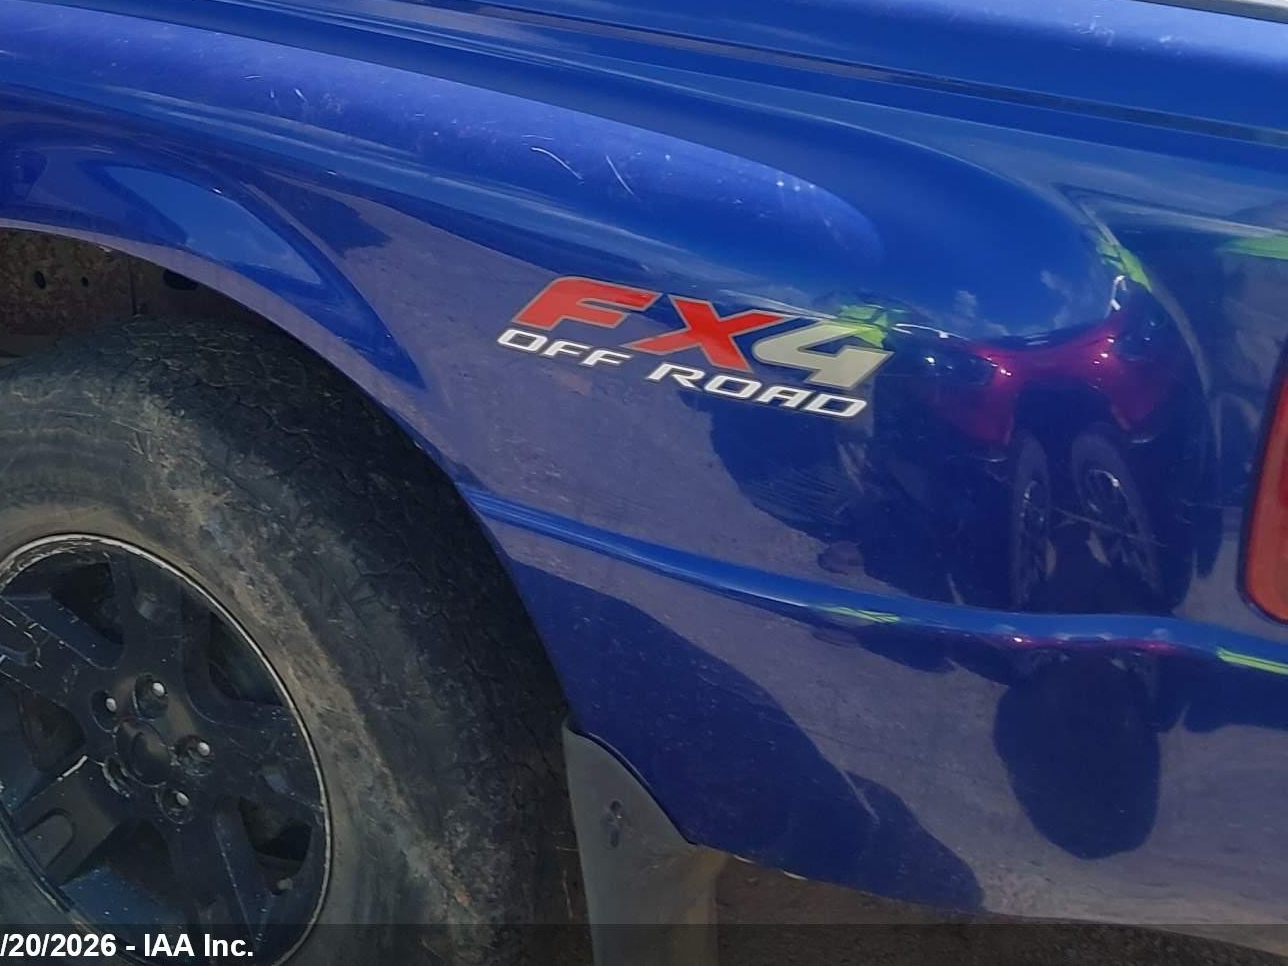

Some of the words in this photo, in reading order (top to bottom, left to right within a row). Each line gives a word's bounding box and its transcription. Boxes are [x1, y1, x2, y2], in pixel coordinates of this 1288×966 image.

[497, 328, 635, 368] OFF
[645, 362, 868, 418] ROAD
[513, 276, 893, 389] FX4
